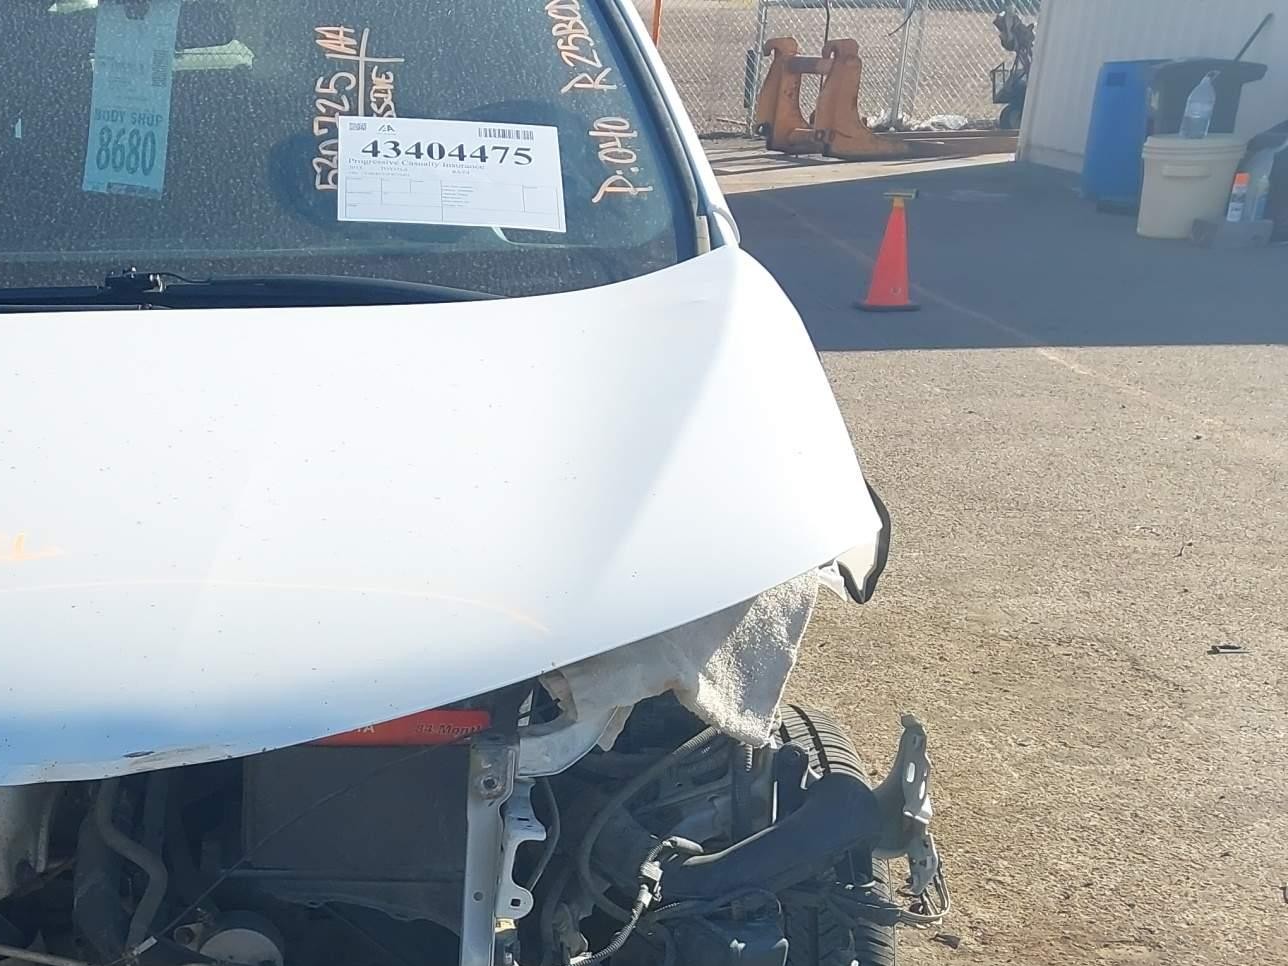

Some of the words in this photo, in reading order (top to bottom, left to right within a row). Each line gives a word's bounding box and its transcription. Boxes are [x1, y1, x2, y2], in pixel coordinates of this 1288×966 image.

[95, 108, 126, 124] BODY
[130, 112, 163, 127] SHOP
[95, 126, 157, 177] 8680
[361, 139, 533, 166] 43404475
[348, 158, 399, 166] Progressive
[401, 159, 440, 168] Casualty
[443, 162, 485, 170] Insurance
